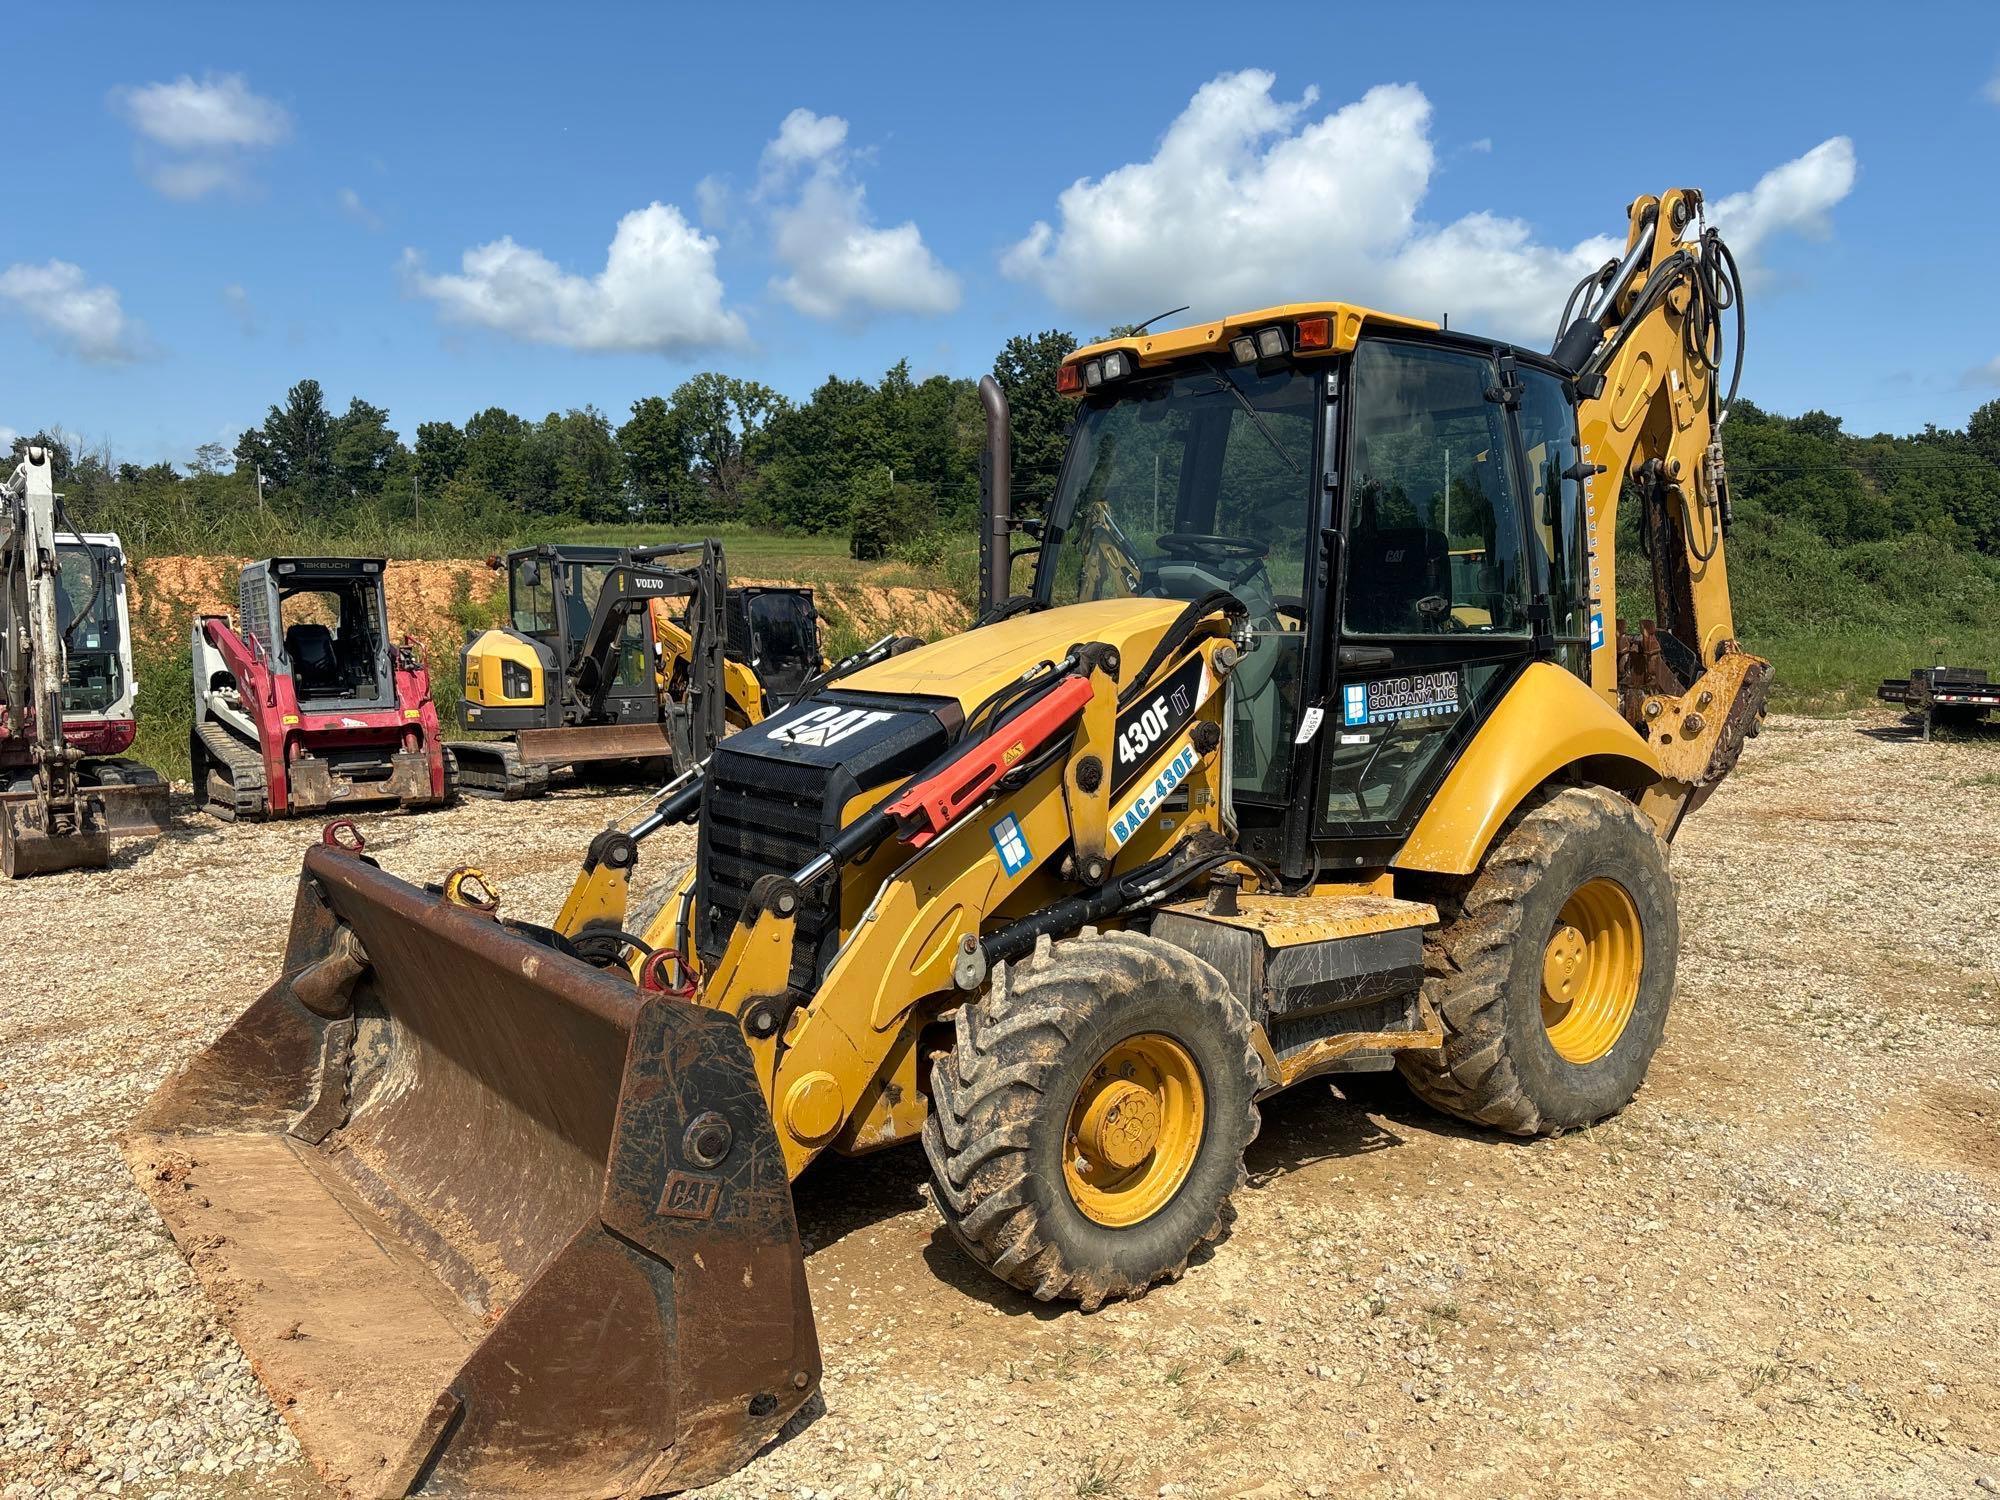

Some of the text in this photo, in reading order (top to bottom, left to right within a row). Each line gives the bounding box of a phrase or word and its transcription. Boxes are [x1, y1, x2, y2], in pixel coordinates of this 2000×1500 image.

[1385, 549, 1406, 562] CAT
[635, 578, 664, 589] VOLVO
[1368, 672, 1458, 697] OTTO BAUM
[1436, 687, 1458, 701] INC.
[1118, 684, 1190, 764] 430F IT
[1368, 704, 1459, 723] CONTRACTORS
[767, 706, 898, 748] CAT
[1113, 747, 1195, 843] BAC-430F
[668, 1180, 717, 1212] CAT
